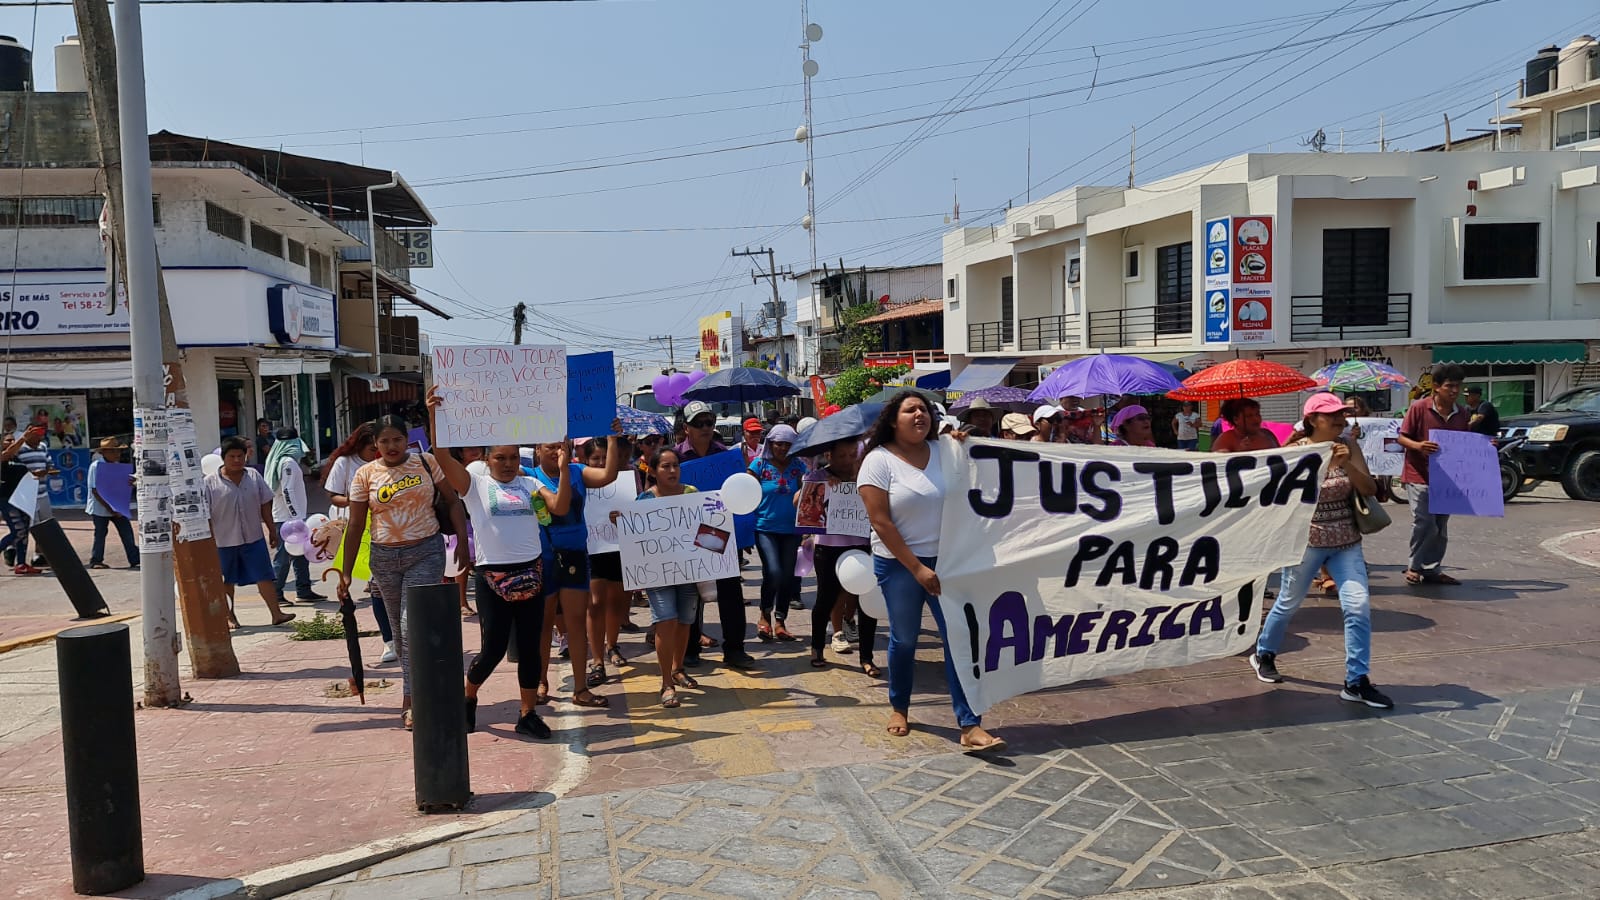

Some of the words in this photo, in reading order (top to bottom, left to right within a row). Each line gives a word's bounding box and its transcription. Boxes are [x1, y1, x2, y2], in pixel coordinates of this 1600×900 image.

[62, 302, 77, 310] Tel
[436, 348, 455, 369] NO
[463, 348, 514, 368] ESTAN
[520, 348, 565, 366] TODAS
[1341, 346, 1382, 357] TIENDA
[377, 474, 422, 503] Cheetos
[967, 444, 1324, 526] JUSTICIA
[620, 510, 646, 536] NO
[625, 562, 659, 588] NOS
[1064, 535, 1221, 592] PARA
